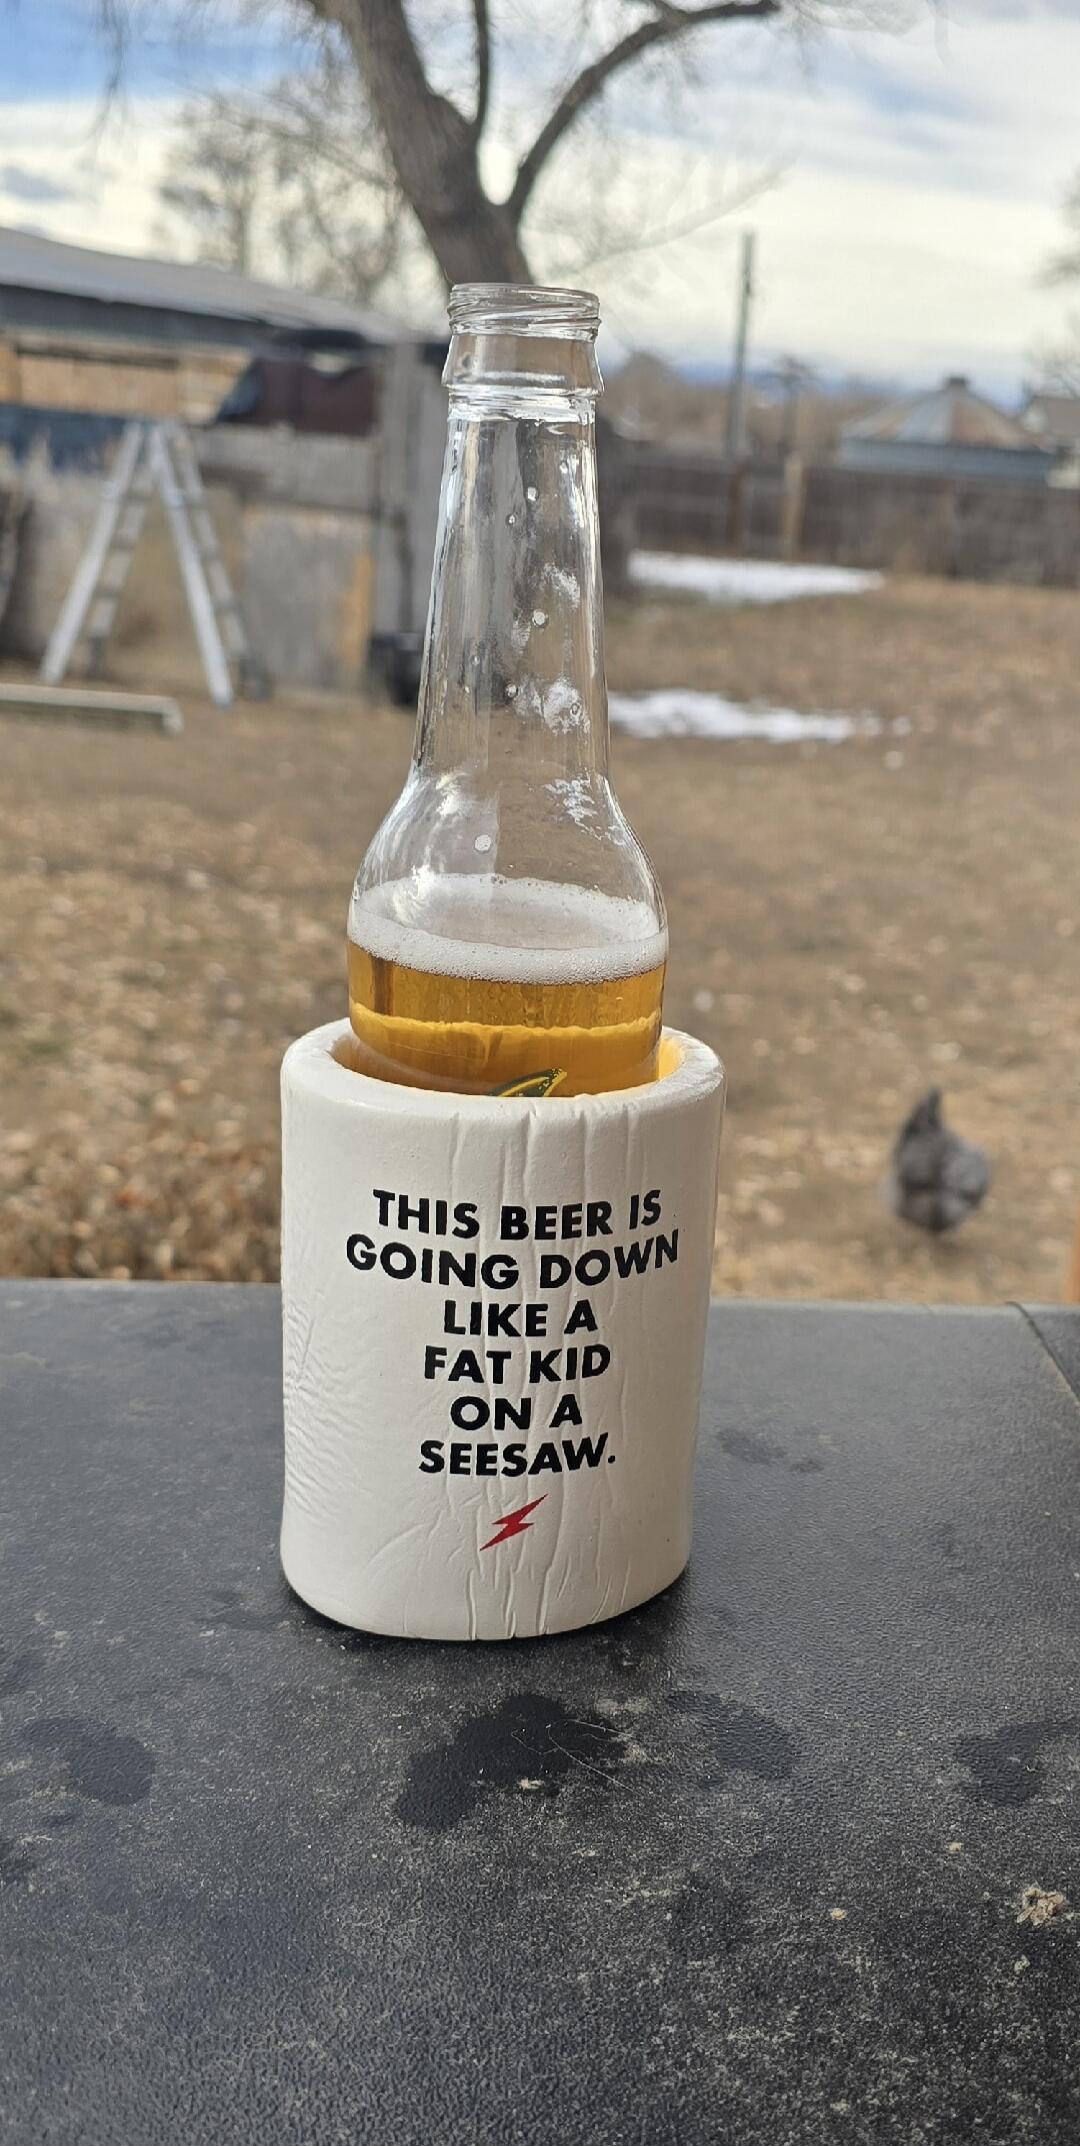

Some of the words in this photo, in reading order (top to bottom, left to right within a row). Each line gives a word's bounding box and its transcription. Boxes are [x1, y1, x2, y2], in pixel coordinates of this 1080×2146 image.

[372, 1189, 480, 1239] THIS
[500, 1200, 614, 1241] BEER
[628, 1189, 662, 1231] IS
[346, 1233, 520, 1290] GOING
[539, 1228, 679, 1289] DOWN
[443, 1299, 549, 1338] LIKE
[563, 1298, 599, 1335] A
[424, 1345, 512, 1385] FAT
[528, 1343, 611, 1384] KID
[450, 1395, 532, 1431] ON
[548, 1393, 583, 1429] A
[418, 1431, 616, 1478] SEESAW.
